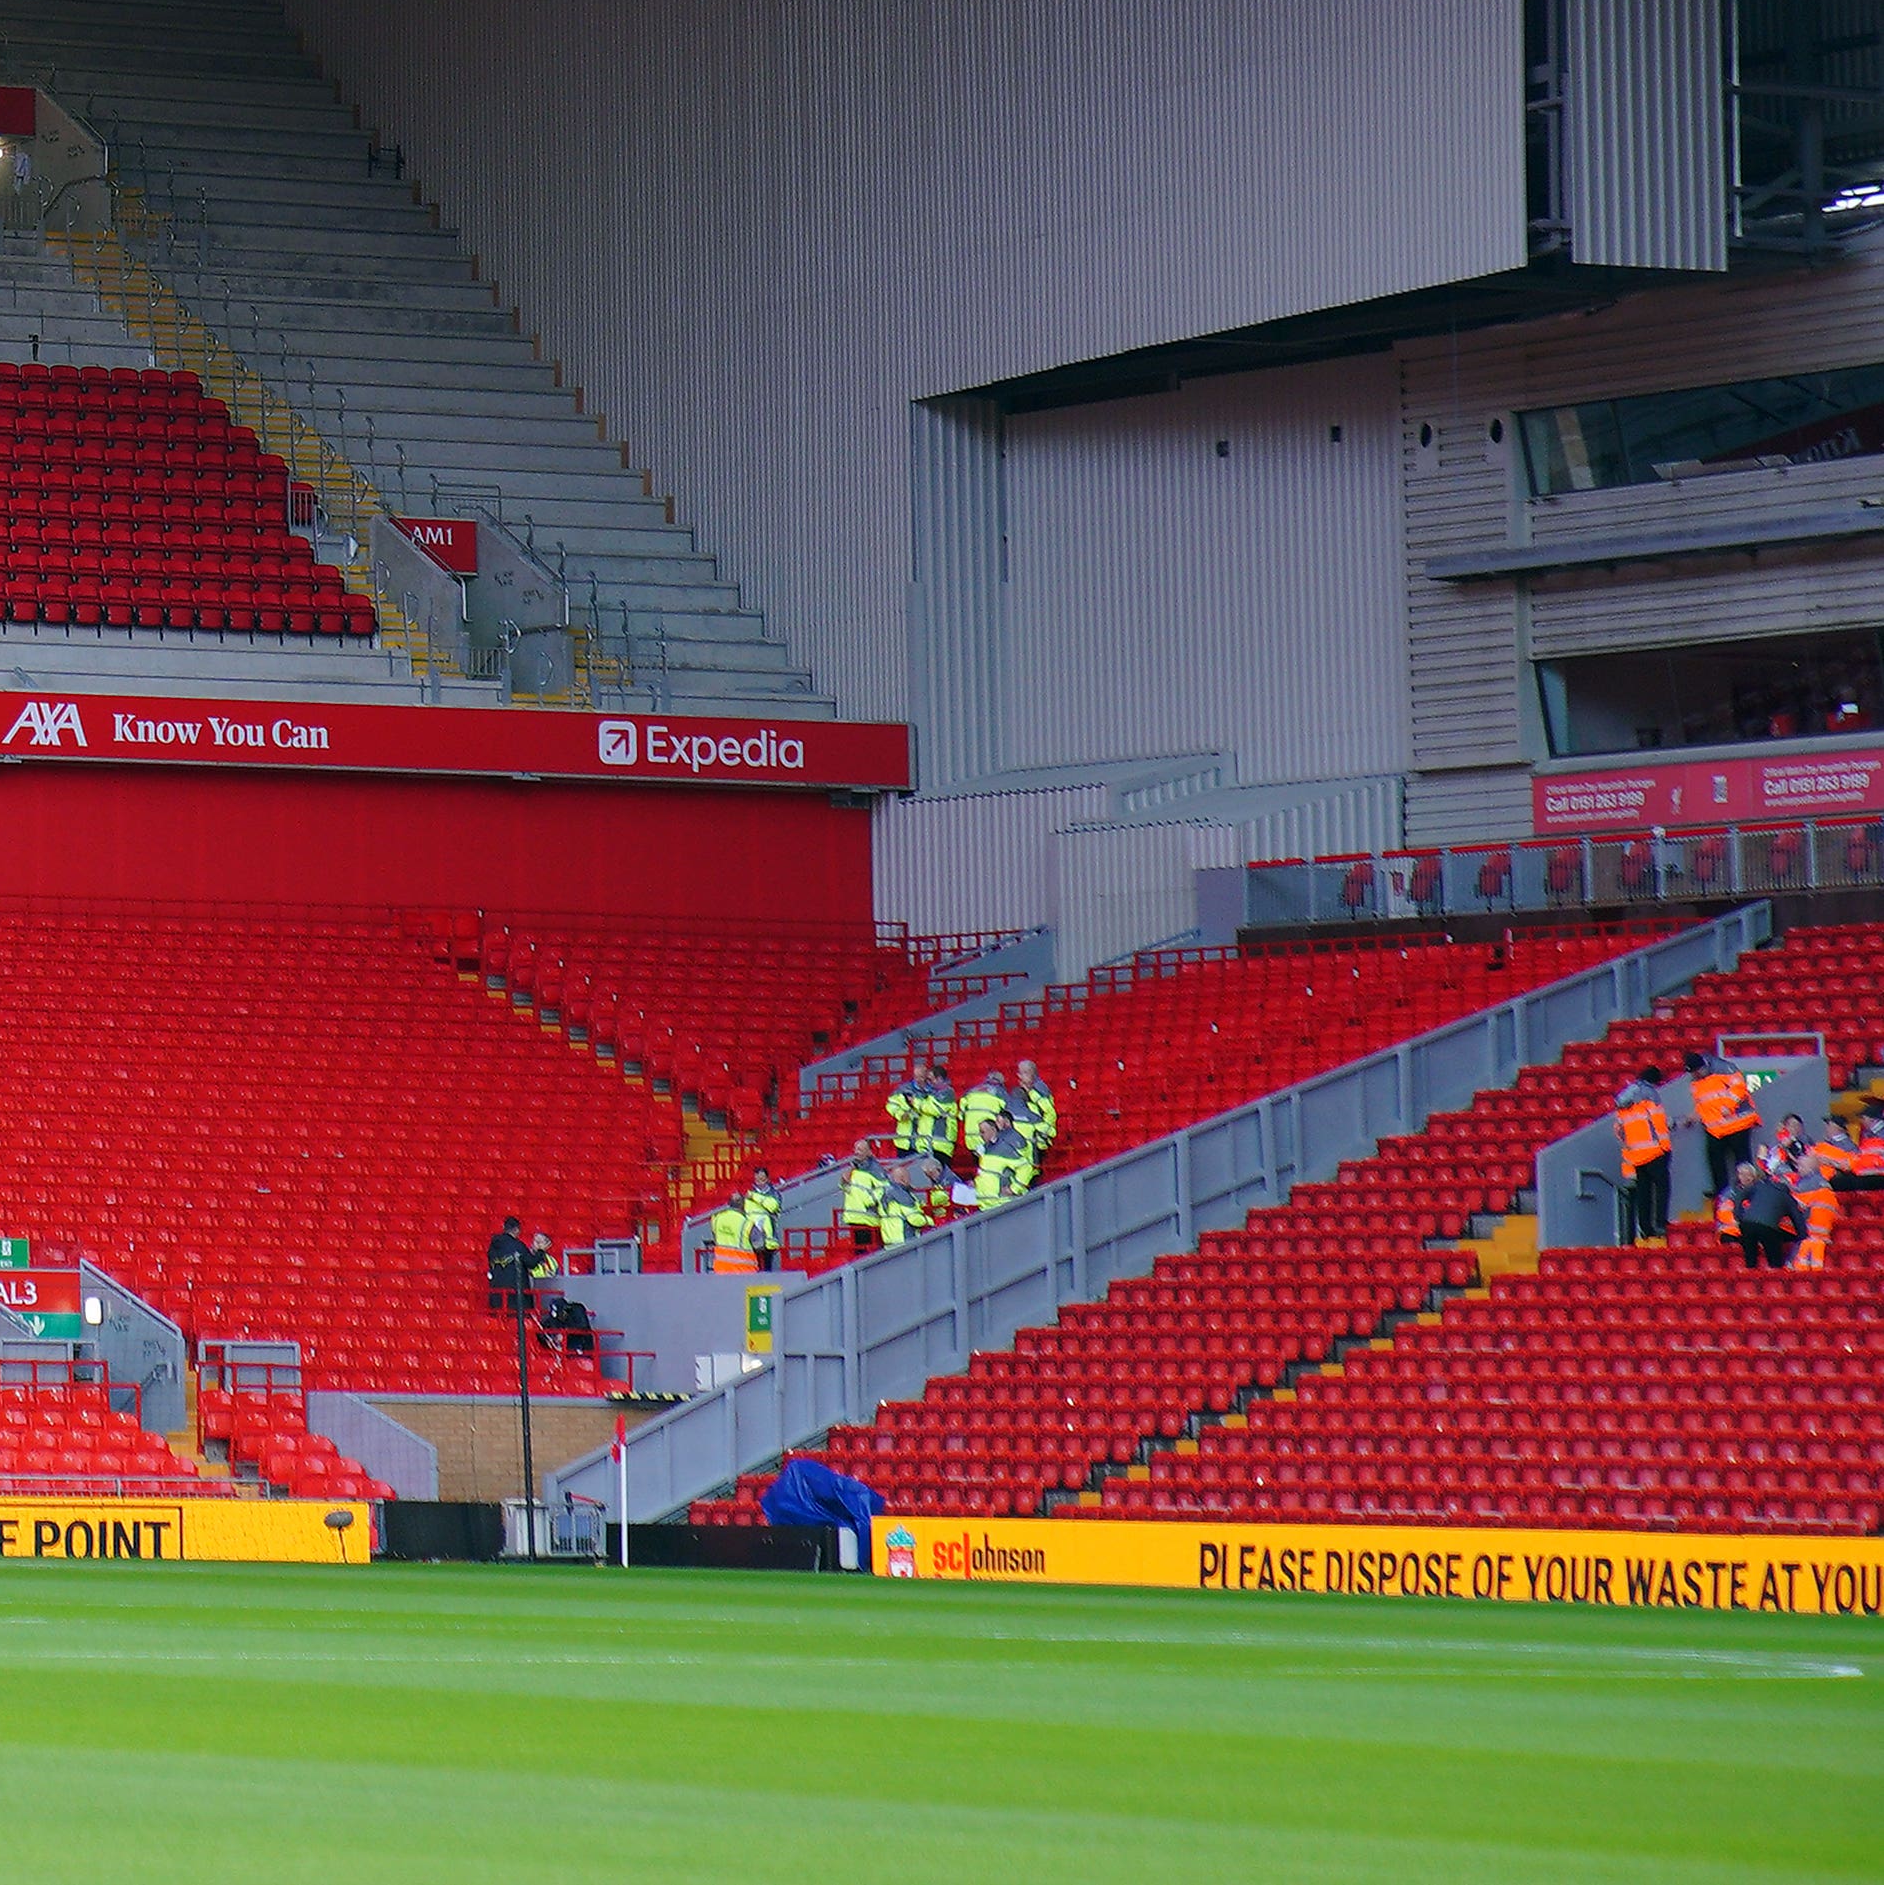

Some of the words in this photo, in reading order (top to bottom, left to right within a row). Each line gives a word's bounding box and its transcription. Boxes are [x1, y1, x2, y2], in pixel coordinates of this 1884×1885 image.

[411, 526, 454, 545] AM1
[2, 702, 88, 747] AXA
[113, 713, 202, 744] Know
[207, 717, 265, 747] You
[272, 720, 330, 749] Can
[646, 726, 804, 773] Expedia
[34, 1520, 171, 1559] POINT
[1198, 1542, 1316, 1592] PLEASE
[1326, 1548, 1464, 1598] DISPOSE
[1472, 1554, 1515, 1600] OF
[1524, 1555, 1615, 1604] YOUR
[1625, 1557, 1749, 1609] WASTE
[1759, 1562, 1802, 1612] AT
